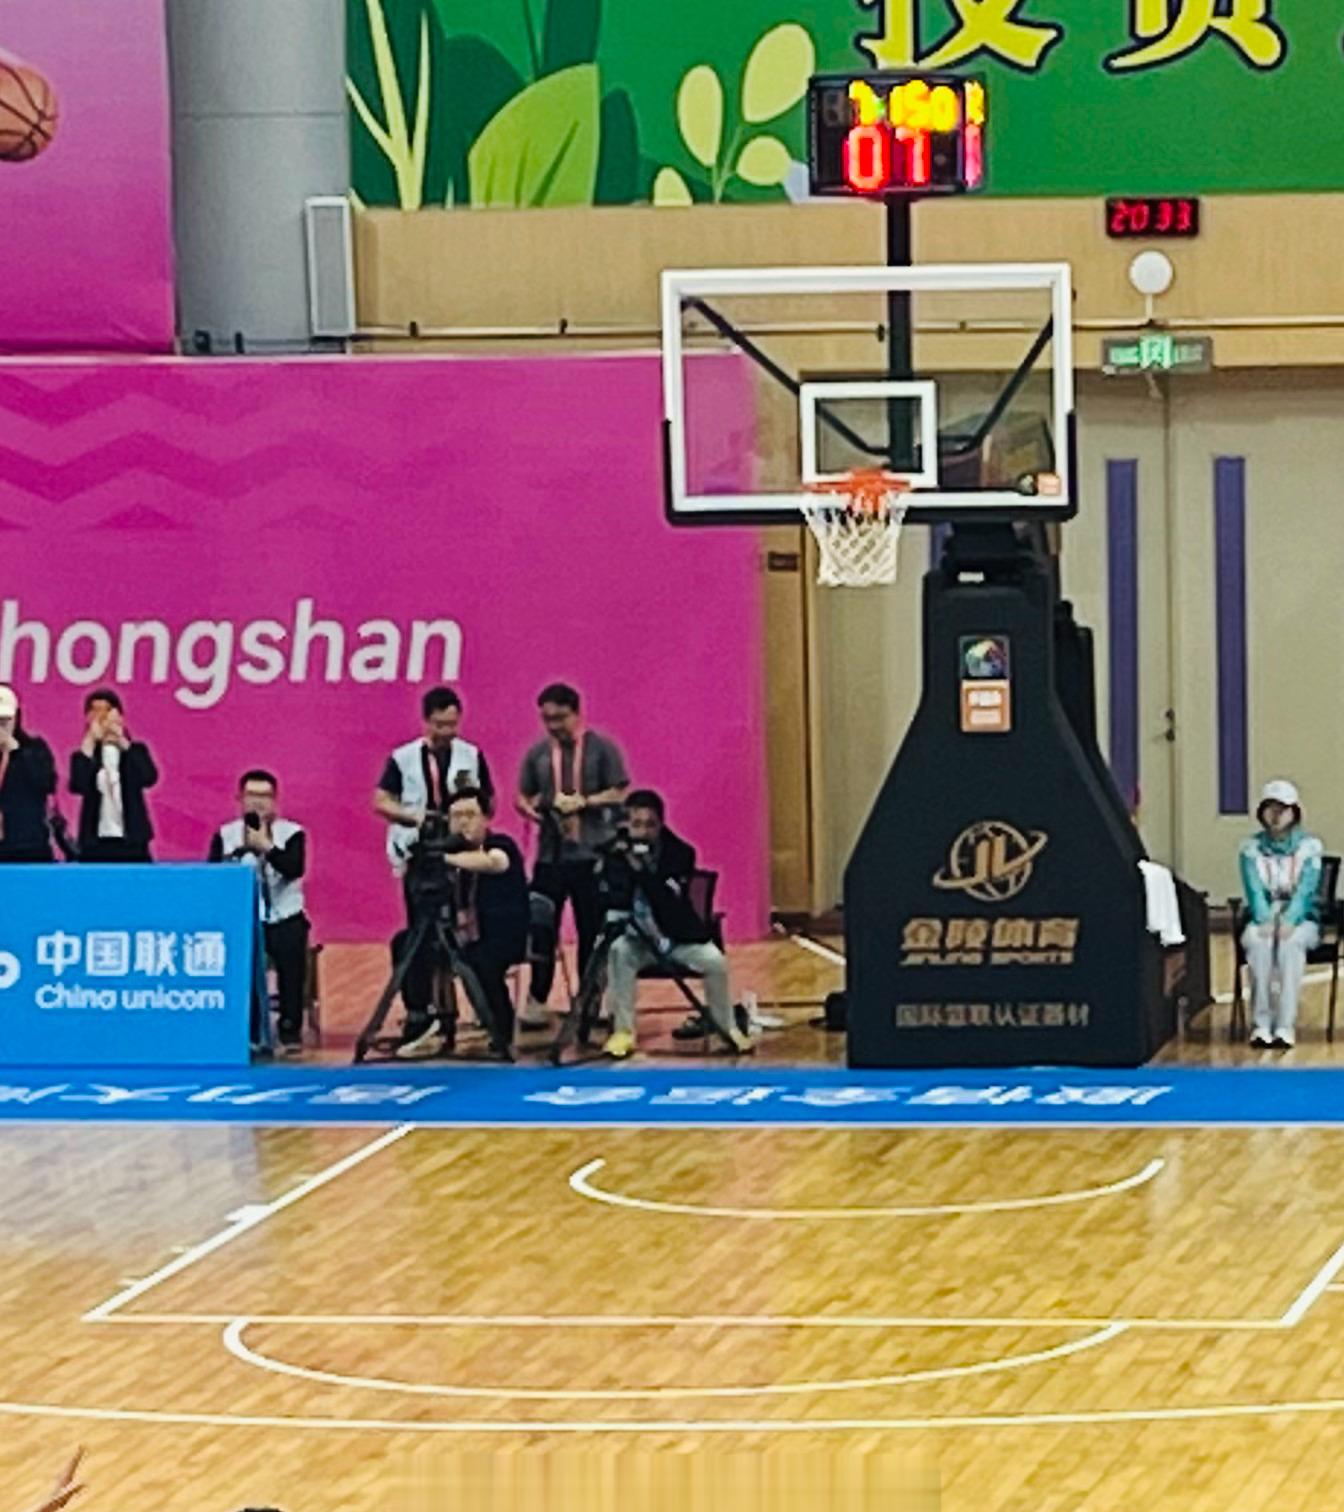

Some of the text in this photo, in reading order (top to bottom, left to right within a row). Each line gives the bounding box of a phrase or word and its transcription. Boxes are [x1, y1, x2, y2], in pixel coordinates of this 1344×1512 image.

[36, 929, 226, 977] 中国联通
[35, 983, 225, 1010] China unicom
